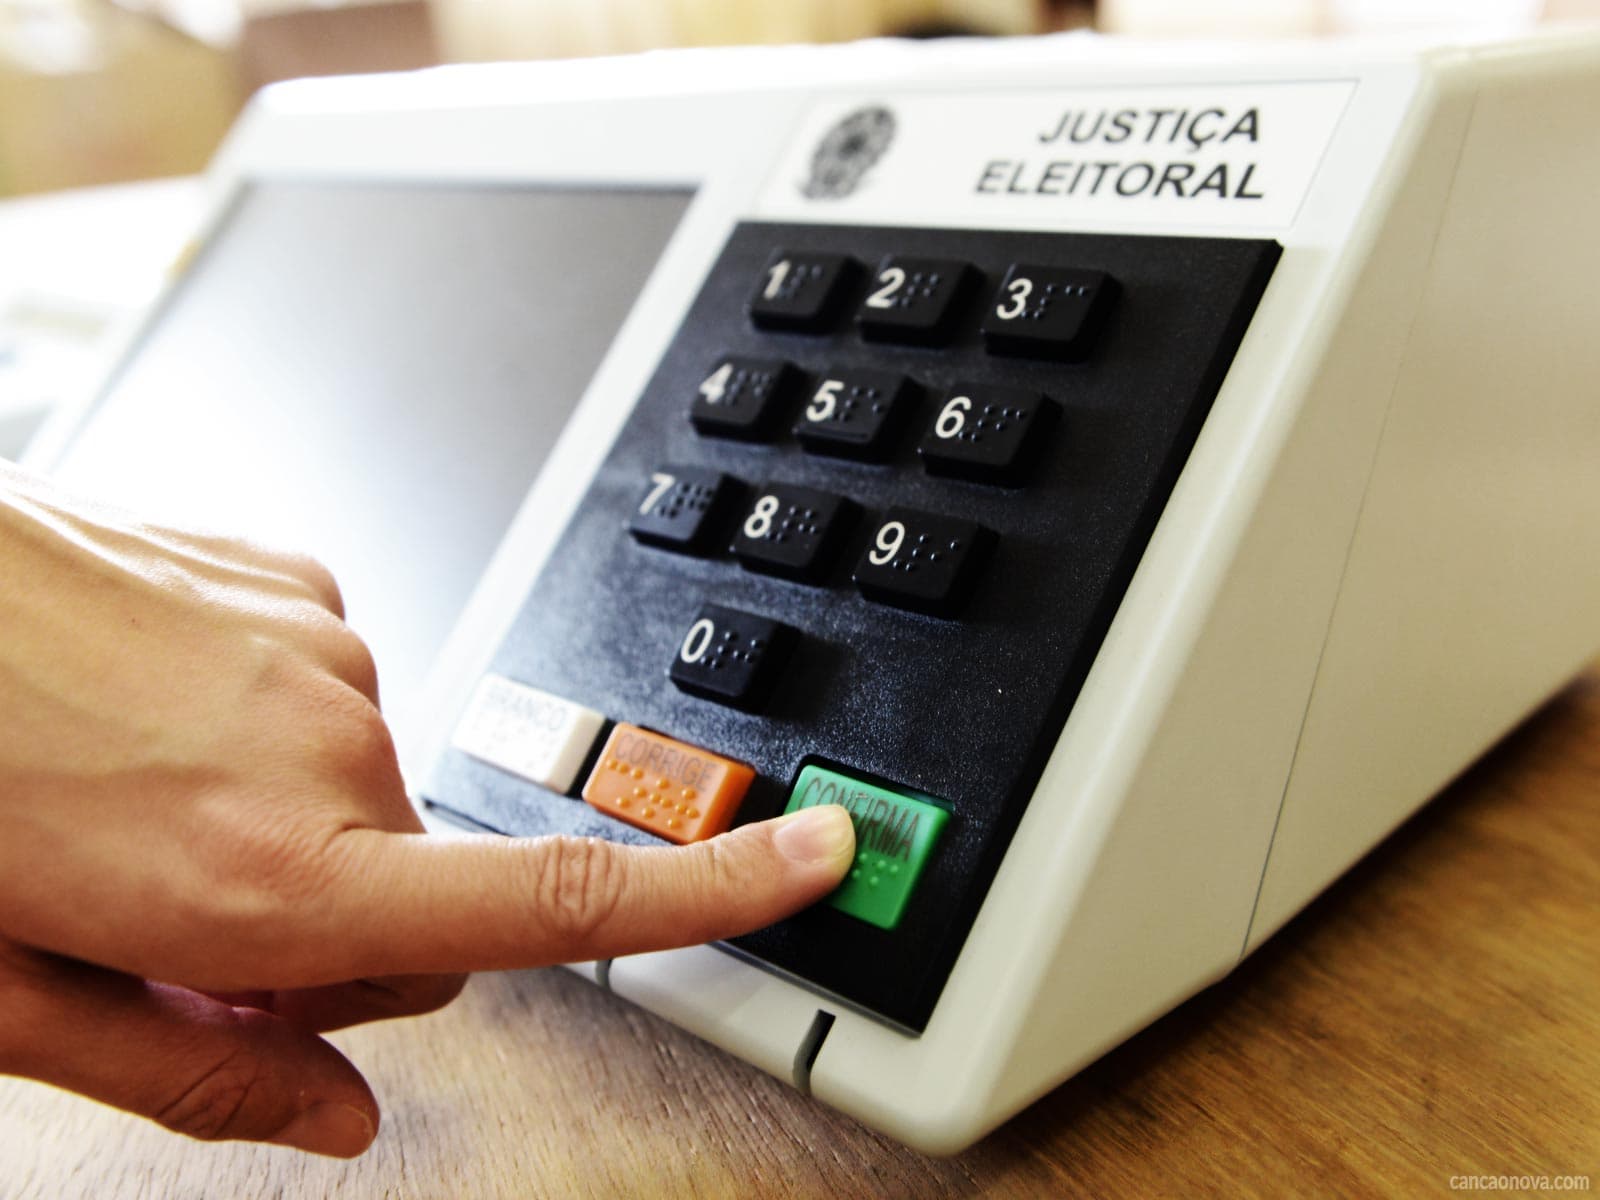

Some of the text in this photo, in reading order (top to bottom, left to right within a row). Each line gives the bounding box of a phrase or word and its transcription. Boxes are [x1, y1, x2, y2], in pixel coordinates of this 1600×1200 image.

[1038, 107, 1259, 152] JUSTIÇA
[974, 161, 1264, 199] ELEITORAL
[764, 260, 790, 299] 1
[866, 267, 906, 308] 2
[996, 278, 1033, 320] 3
[697, 363, 733, 404] 4
[806, 379, 844, 422] 5
[935, 396, 972, 439] 6
[639, 473, 675, 514] 7
[743, 495, 780, 539] 8
[869, 521, 906, 566] 9
[677, 618, 715, 664] 0
[615, 733, 717, 792] CORRIGE
